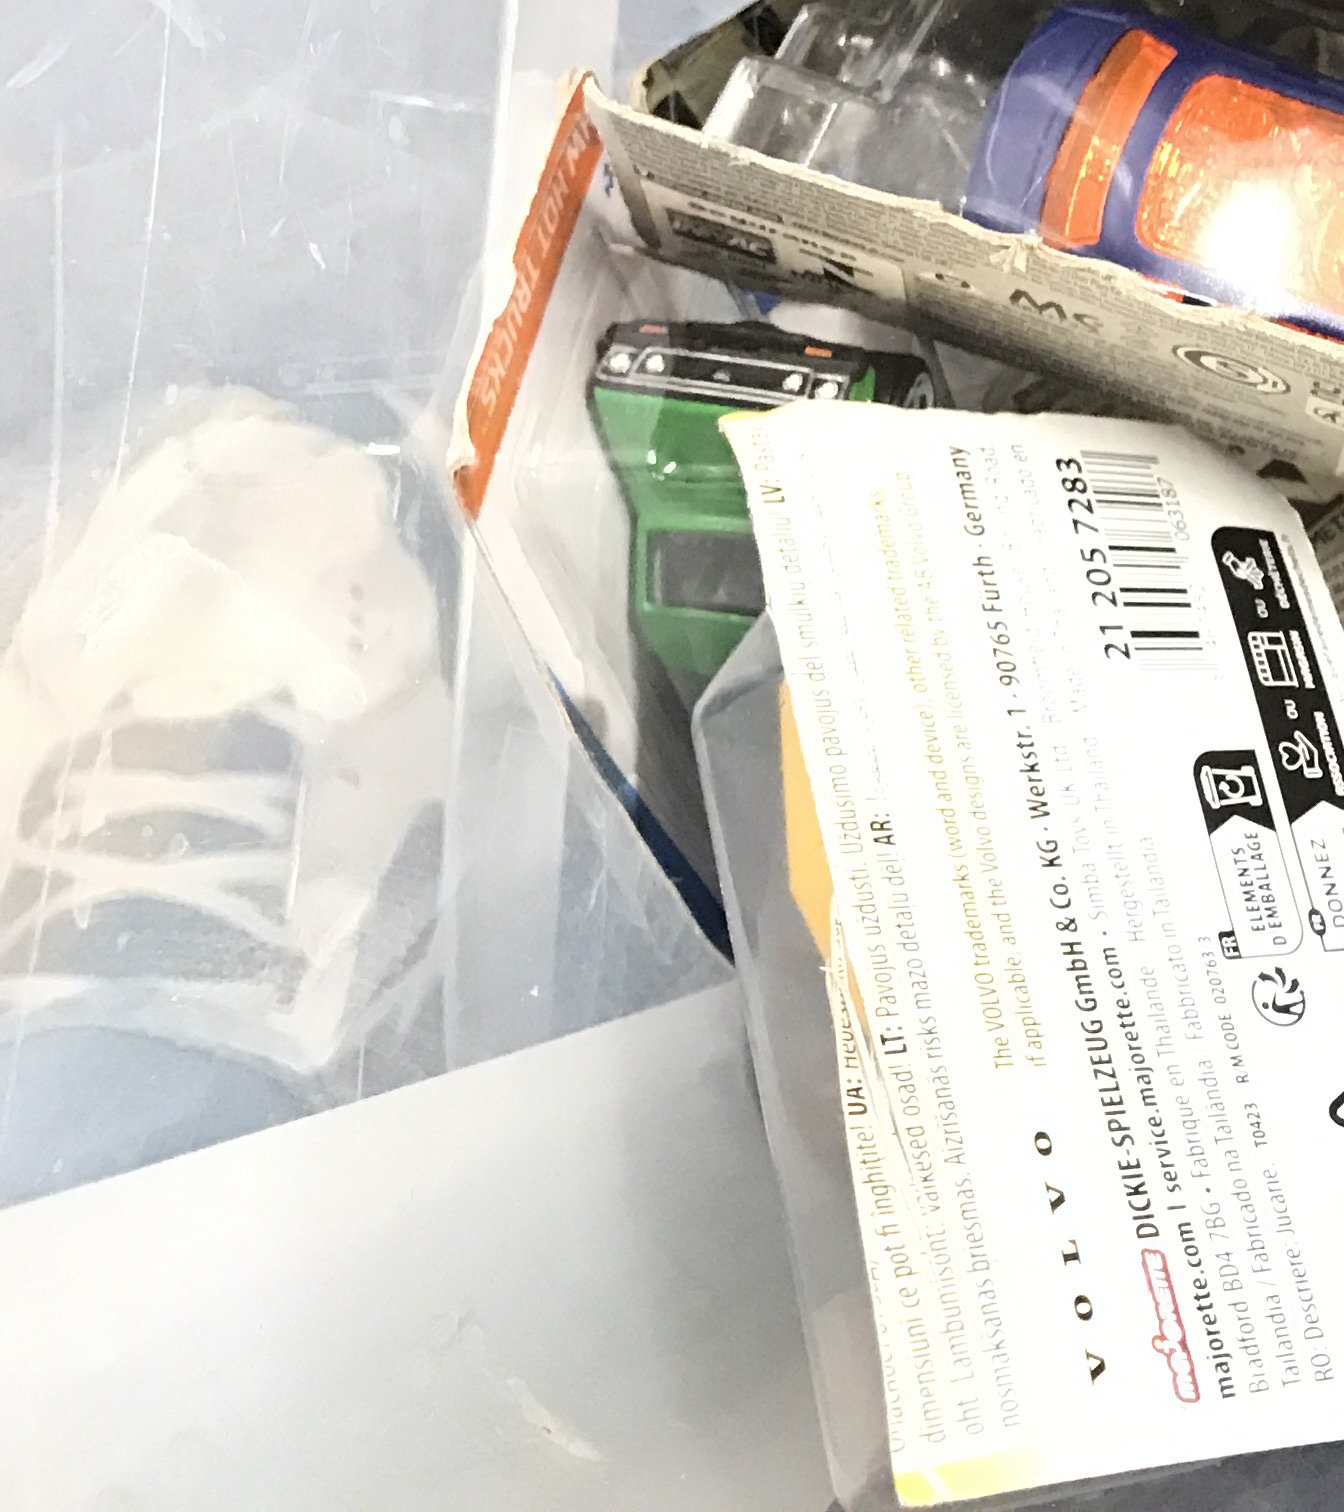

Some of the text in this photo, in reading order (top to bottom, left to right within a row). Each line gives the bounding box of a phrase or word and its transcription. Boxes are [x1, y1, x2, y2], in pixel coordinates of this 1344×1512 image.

[474, 170, 573, 417] HOT TRUCKS
[943, 440, 990, 539] Germany
[1055, 452, 1130, 664] 21 205 7283
[985, 617, 1022, 688] 90765
[970, 823, 1001, 875] Volvo
[1006, 723, 1101, 1014] GmbH Co. KG Werkstr.
[949, 862, 993, 967] trademarks
[862, 940, 907, 1020] Pavojus
[972, 970, 1007, 1033] VOLVO
[1079, 1016, 1161, 1242] DICKIE-SPIELZEUG
[1095, 942, 1242, 1402] majorette.com service.majorette.com
[1243, 1100, 1268, 1148] T0423
[944, 1169, 997, 1275] briesmas.
[1200, 1199, 1271, 1395] Bradford BD4 7BG
[893, 1315, 956, 1447] dimensiuni
